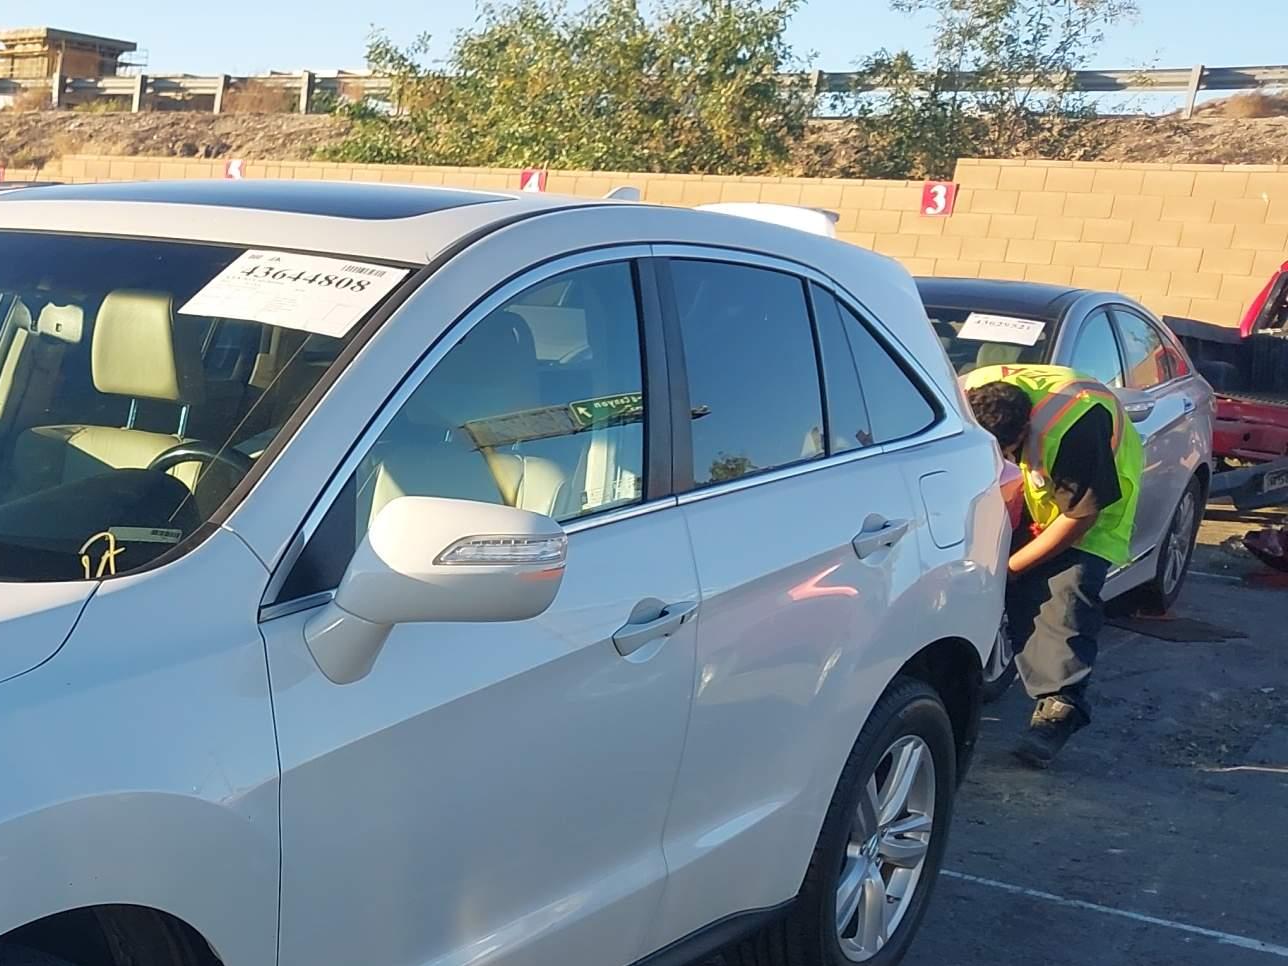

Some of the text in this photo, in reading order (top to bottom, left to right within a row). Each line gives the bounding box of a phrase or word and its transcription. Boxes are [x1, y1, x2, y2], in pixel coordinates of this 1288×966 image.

[521, 170, 541, 192] 4
[924, 183, 948, 215] 3
[241, 265, 372, 292] 43644808
